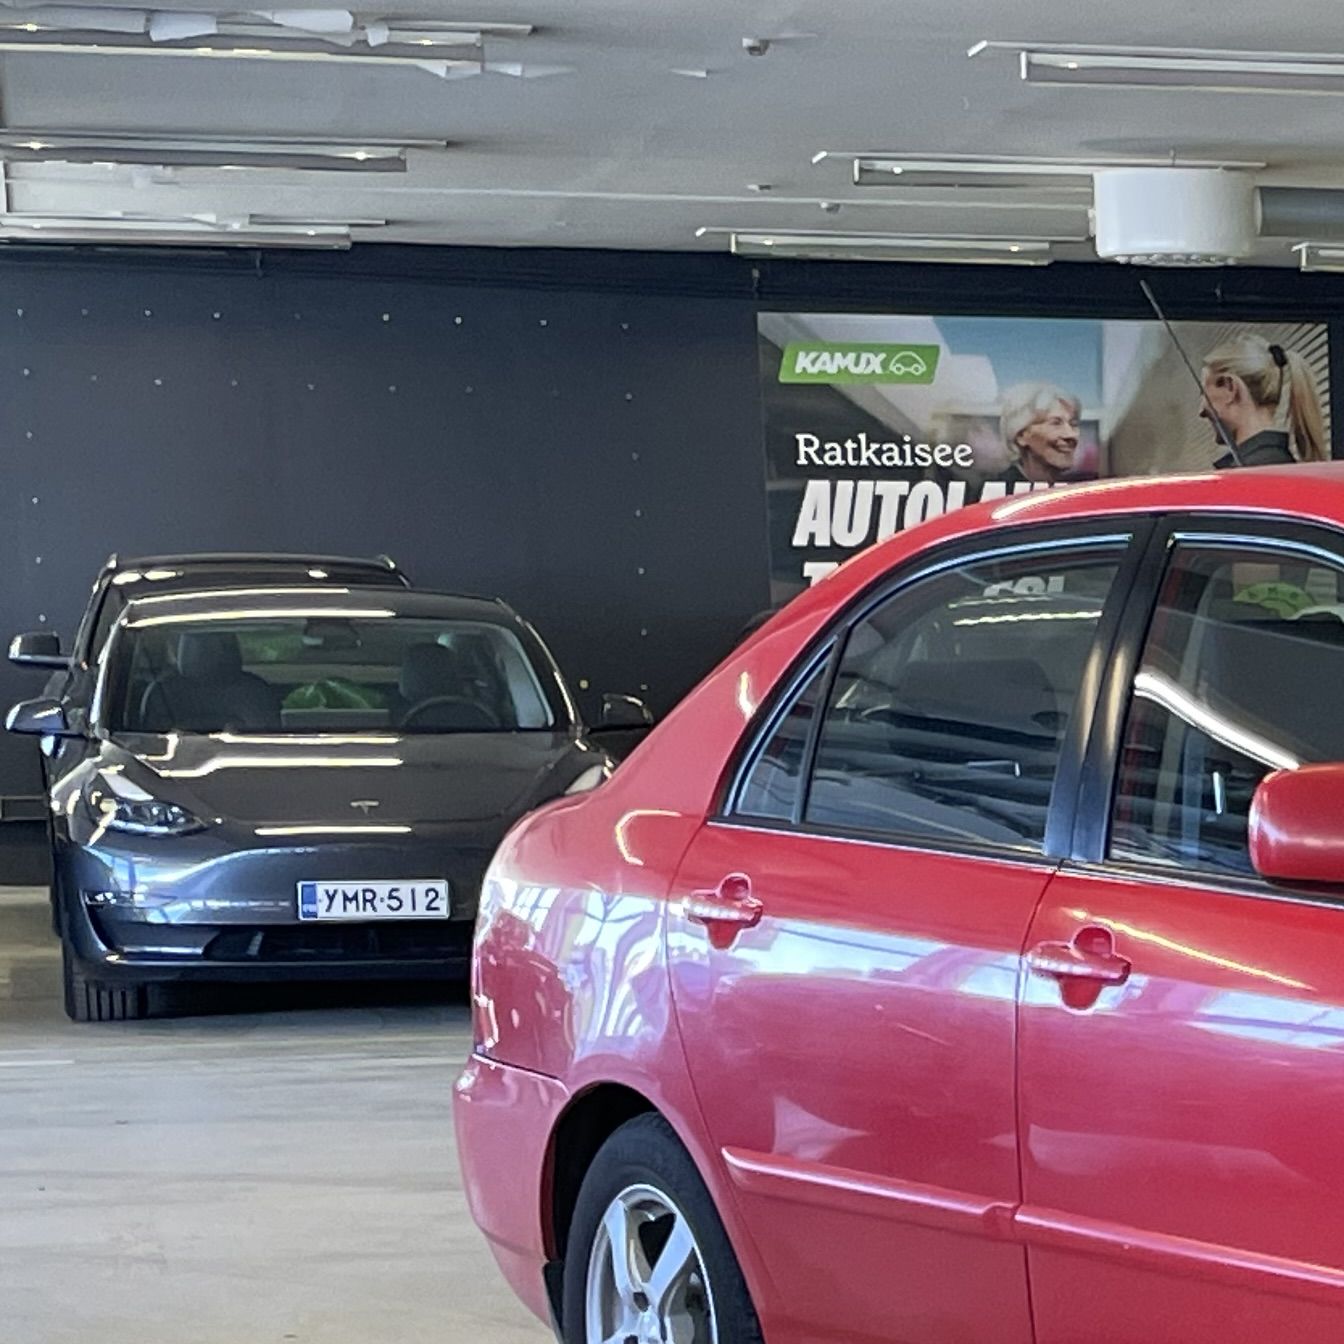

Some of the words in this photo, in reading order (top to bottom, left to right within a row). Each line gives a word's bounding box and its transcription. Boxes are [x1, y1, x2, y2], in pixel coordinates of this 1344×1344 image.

[795, 350, 887, 375] KAMUX
[795, 432, 975, 468] Ratkaisee
[324, 887, 441, 913] YMR-512
